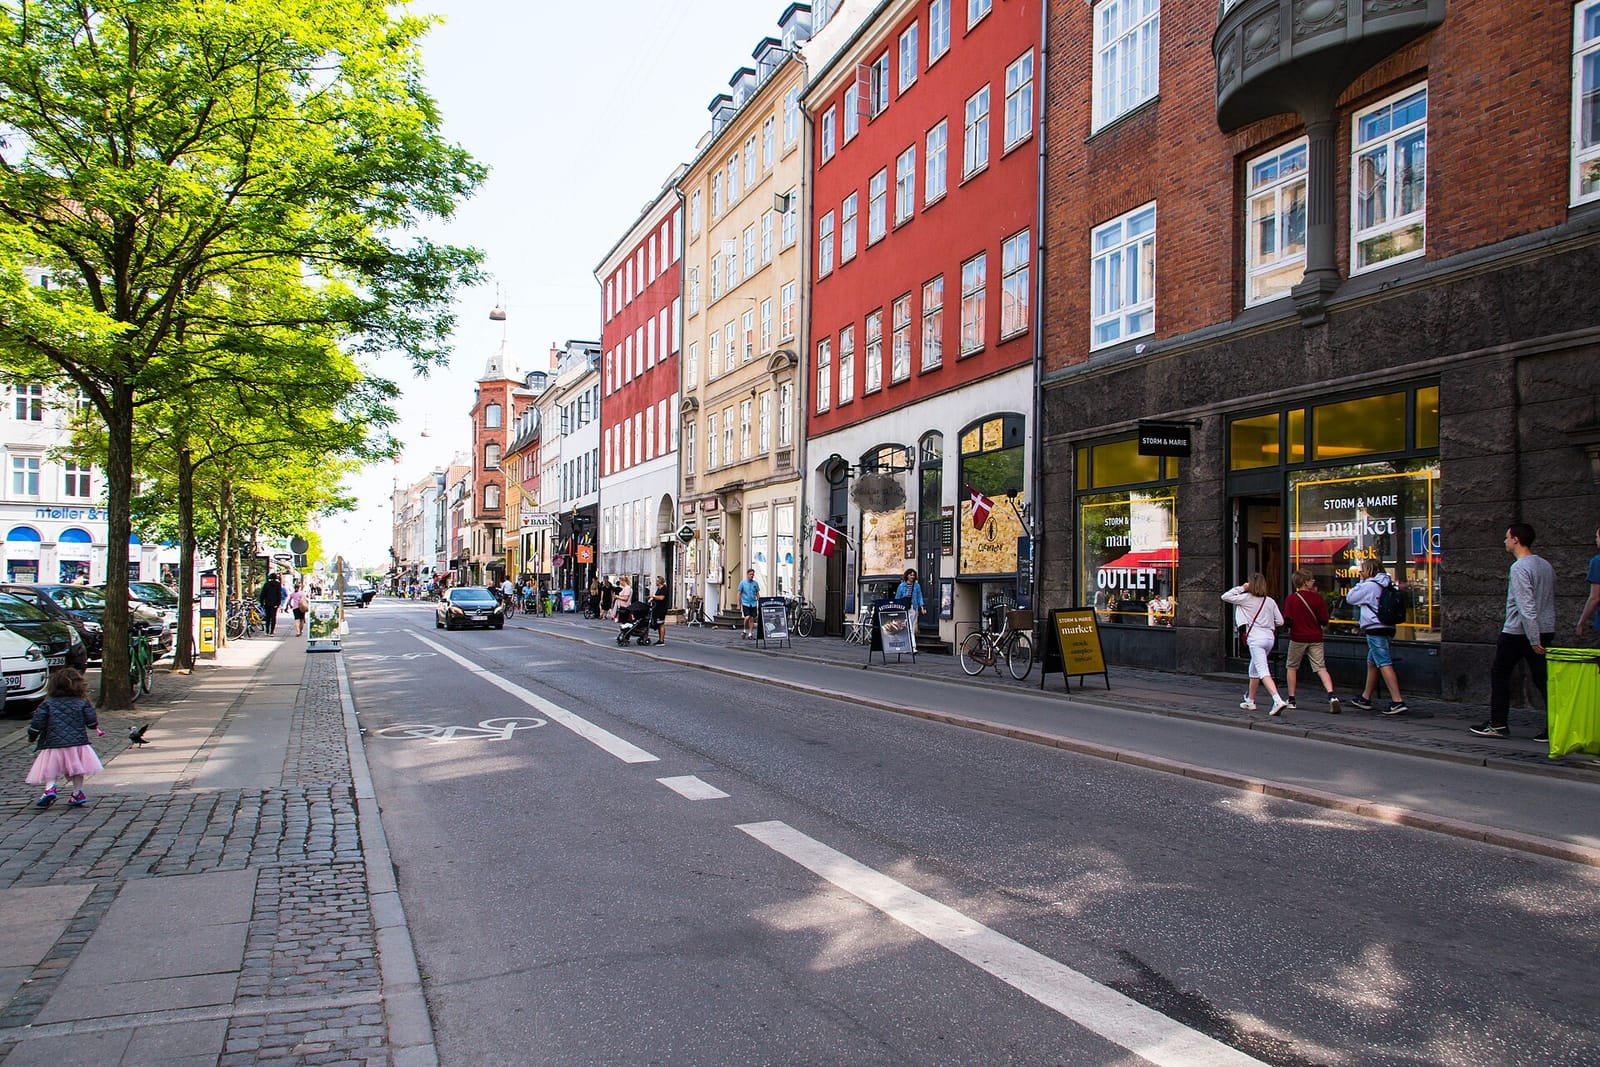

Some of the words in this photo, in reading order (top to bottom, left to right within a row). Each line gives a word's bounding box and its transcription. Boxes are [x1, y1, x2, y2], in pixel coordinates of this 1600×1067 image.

[1142, 437, 1162, 445] STORM
[1324, 499, 1355, 510] STORM
[1357, 497, 1365, 508] &
[1366, 495, 1398, 507] MARIE
[36, 507, 85, 520] møller
[87, 508, 99, 520] &
[1104, 517, 1124, 527] STORM
[1124, 516, 1129, 525] &
[1325, 516, 1396, 537] market
[1343, 545, 1377, 560] stock
[1097, 568, 1157, 589] OUTLET
[1061, 624, 1094, 635] market
[5, 676, 20, 686] 390
